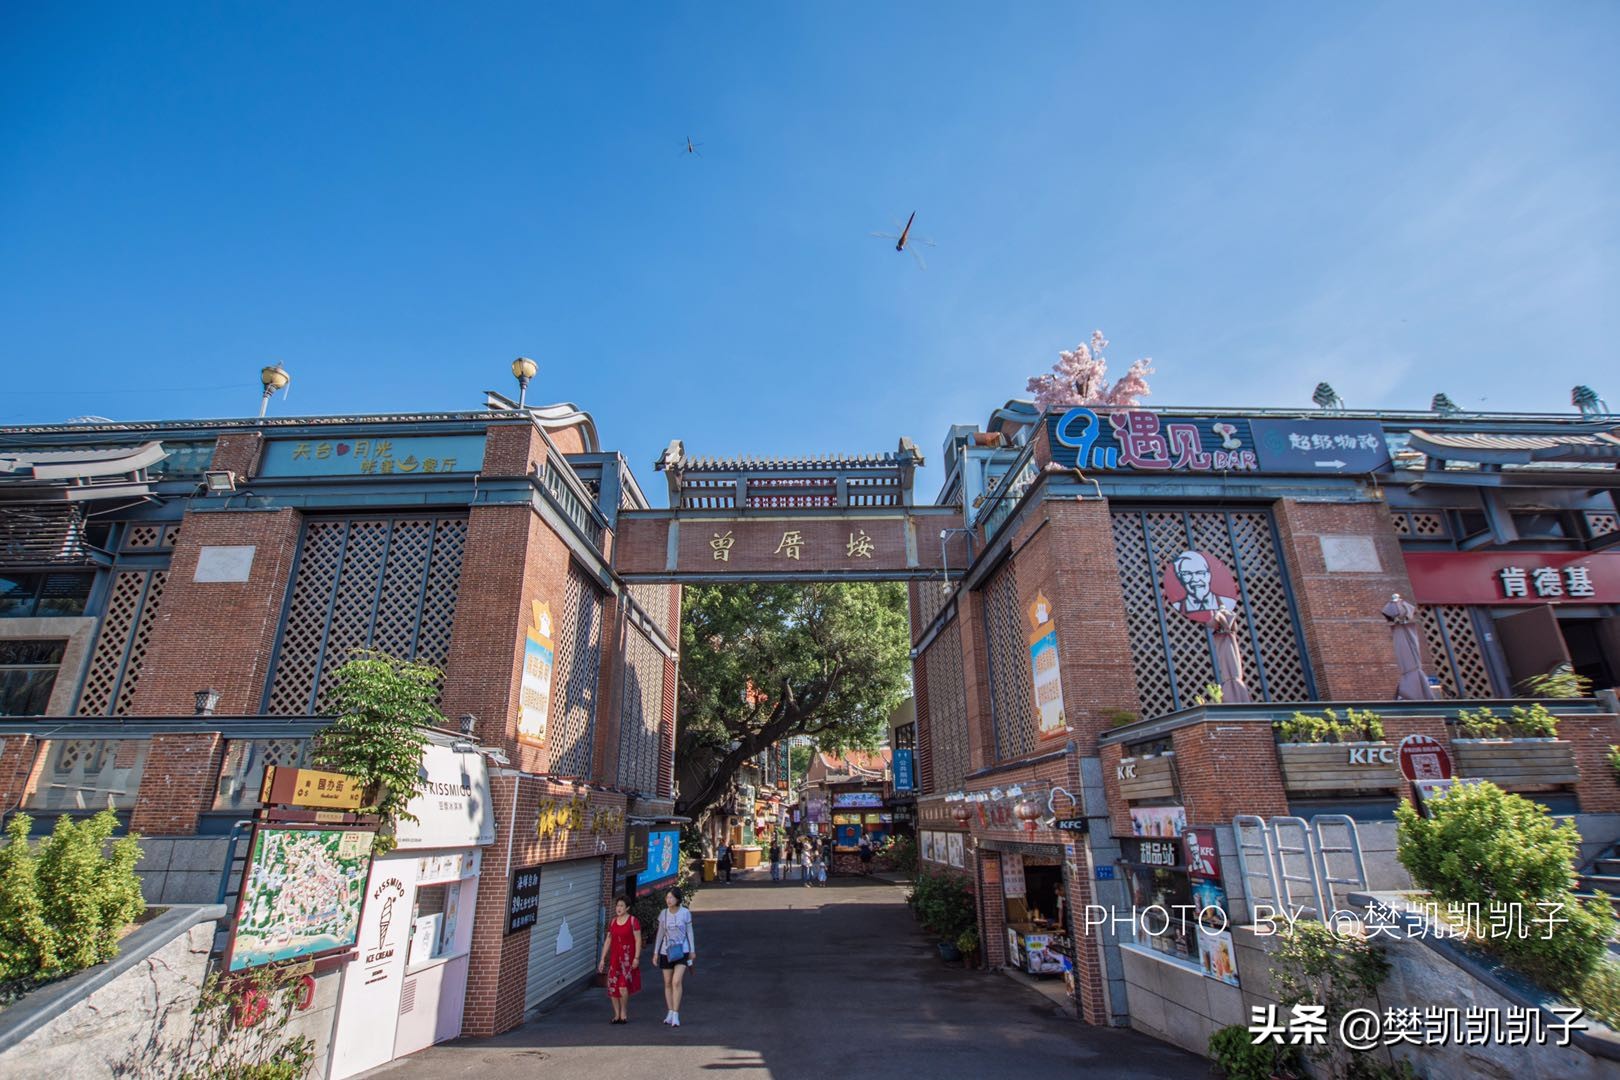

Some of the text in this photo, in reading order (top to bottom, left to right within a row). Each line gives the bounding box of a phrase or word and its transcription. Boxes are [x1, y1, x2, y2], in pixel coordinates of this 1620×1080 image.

[1109, 411, 1212, 469] 遇见
[1213, 450, 1258, 470] BAR
[1288, 432, 1379, 453] 超级物种
[709, 529, 875, 562] 曾厝垵
[1500, 566, 1595, 597] 肯德基
[1349, 747, 1394, 764] KFC
[1117, 764, 1137, 780] KFC
[1060, 820, 1082, 829] KFC
[1200, 846, 1215, 857] KFC
[366, 949, 394, 964] ICE CREAM
